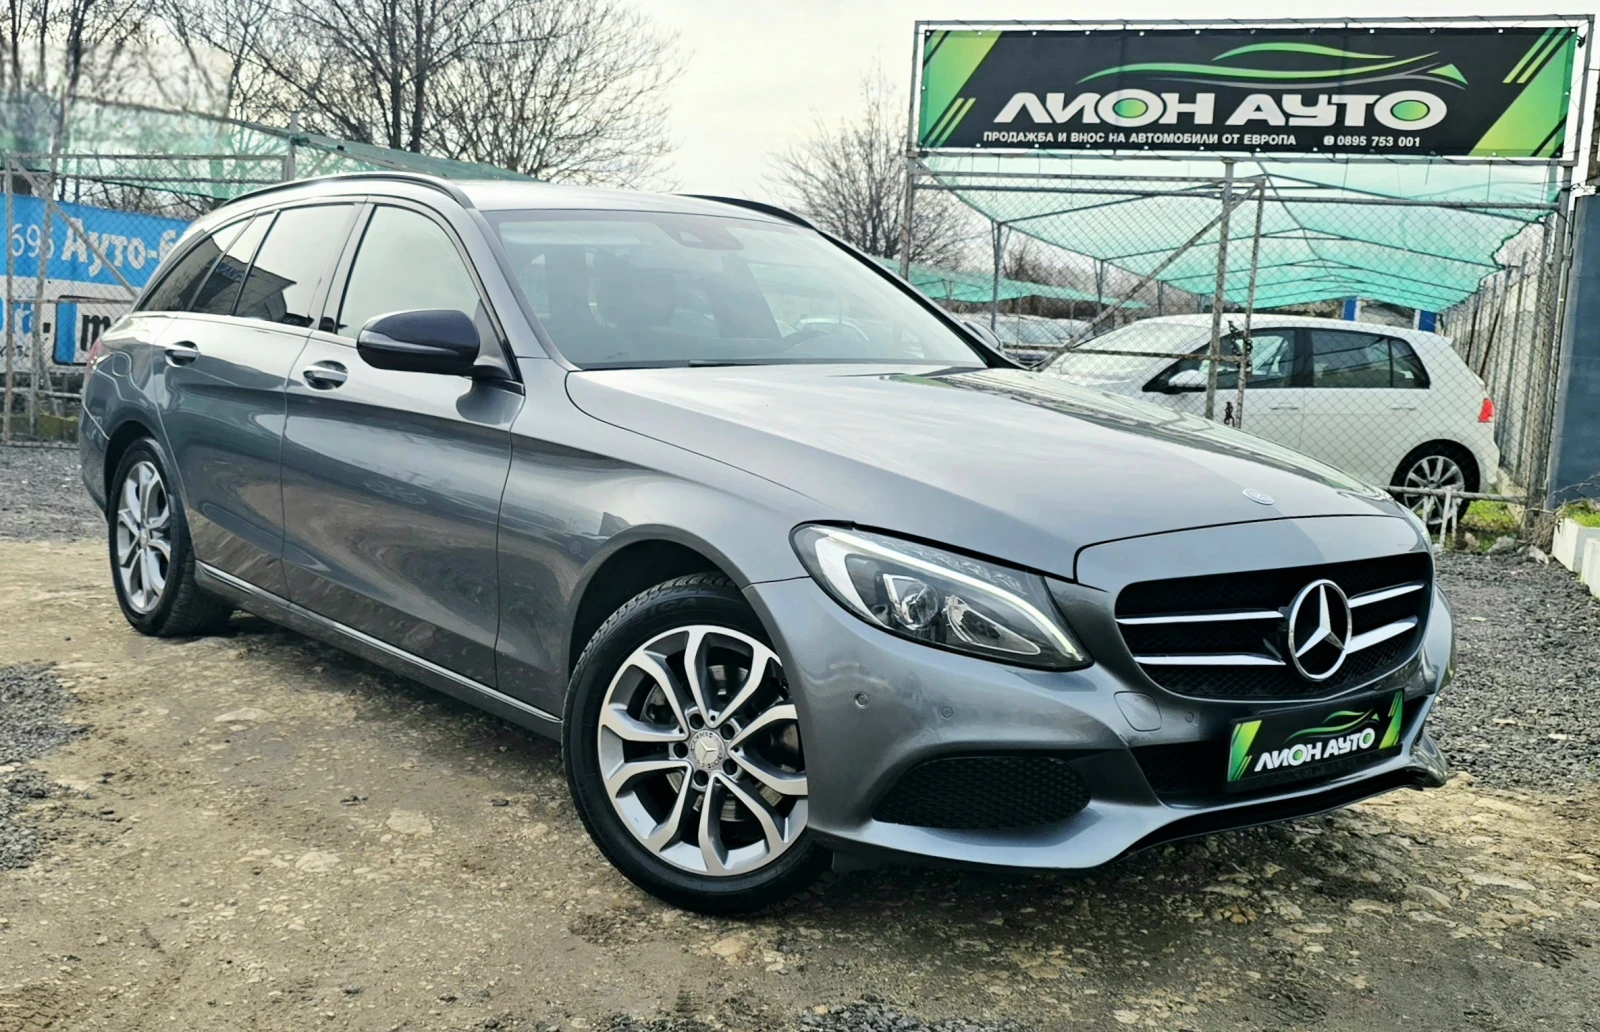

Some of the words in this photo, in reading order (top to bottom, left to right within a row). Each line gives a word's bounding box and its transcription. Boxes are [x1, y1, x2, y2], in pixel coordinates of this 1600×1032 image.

[993, 88, 1217, 130] ЛИОН
[1225, 90, 1448, 131] АУТО
[983, 131, 1054, 143] ПРОДАЖБА
[1058, 132, 1067, 143] И
[1070, 132, 1105, 143] ВНОС
[1109, 133, 1125, 144] НА
[1129, 133, 1219, 145] АВТОМОБИЛИ
[1222, 134, 1240, 145] ОТ
[1243, 134, 1297, 146] ЕВРОПА
[1336, 136, 1367, 146] 0895
[1371, 136, 1395, 147] 753
[1398, 136, 1421, 148] 001
[1254, 742, 1323, 772] ЛИОН
[1323, 727, 1376, 759] АУТО
